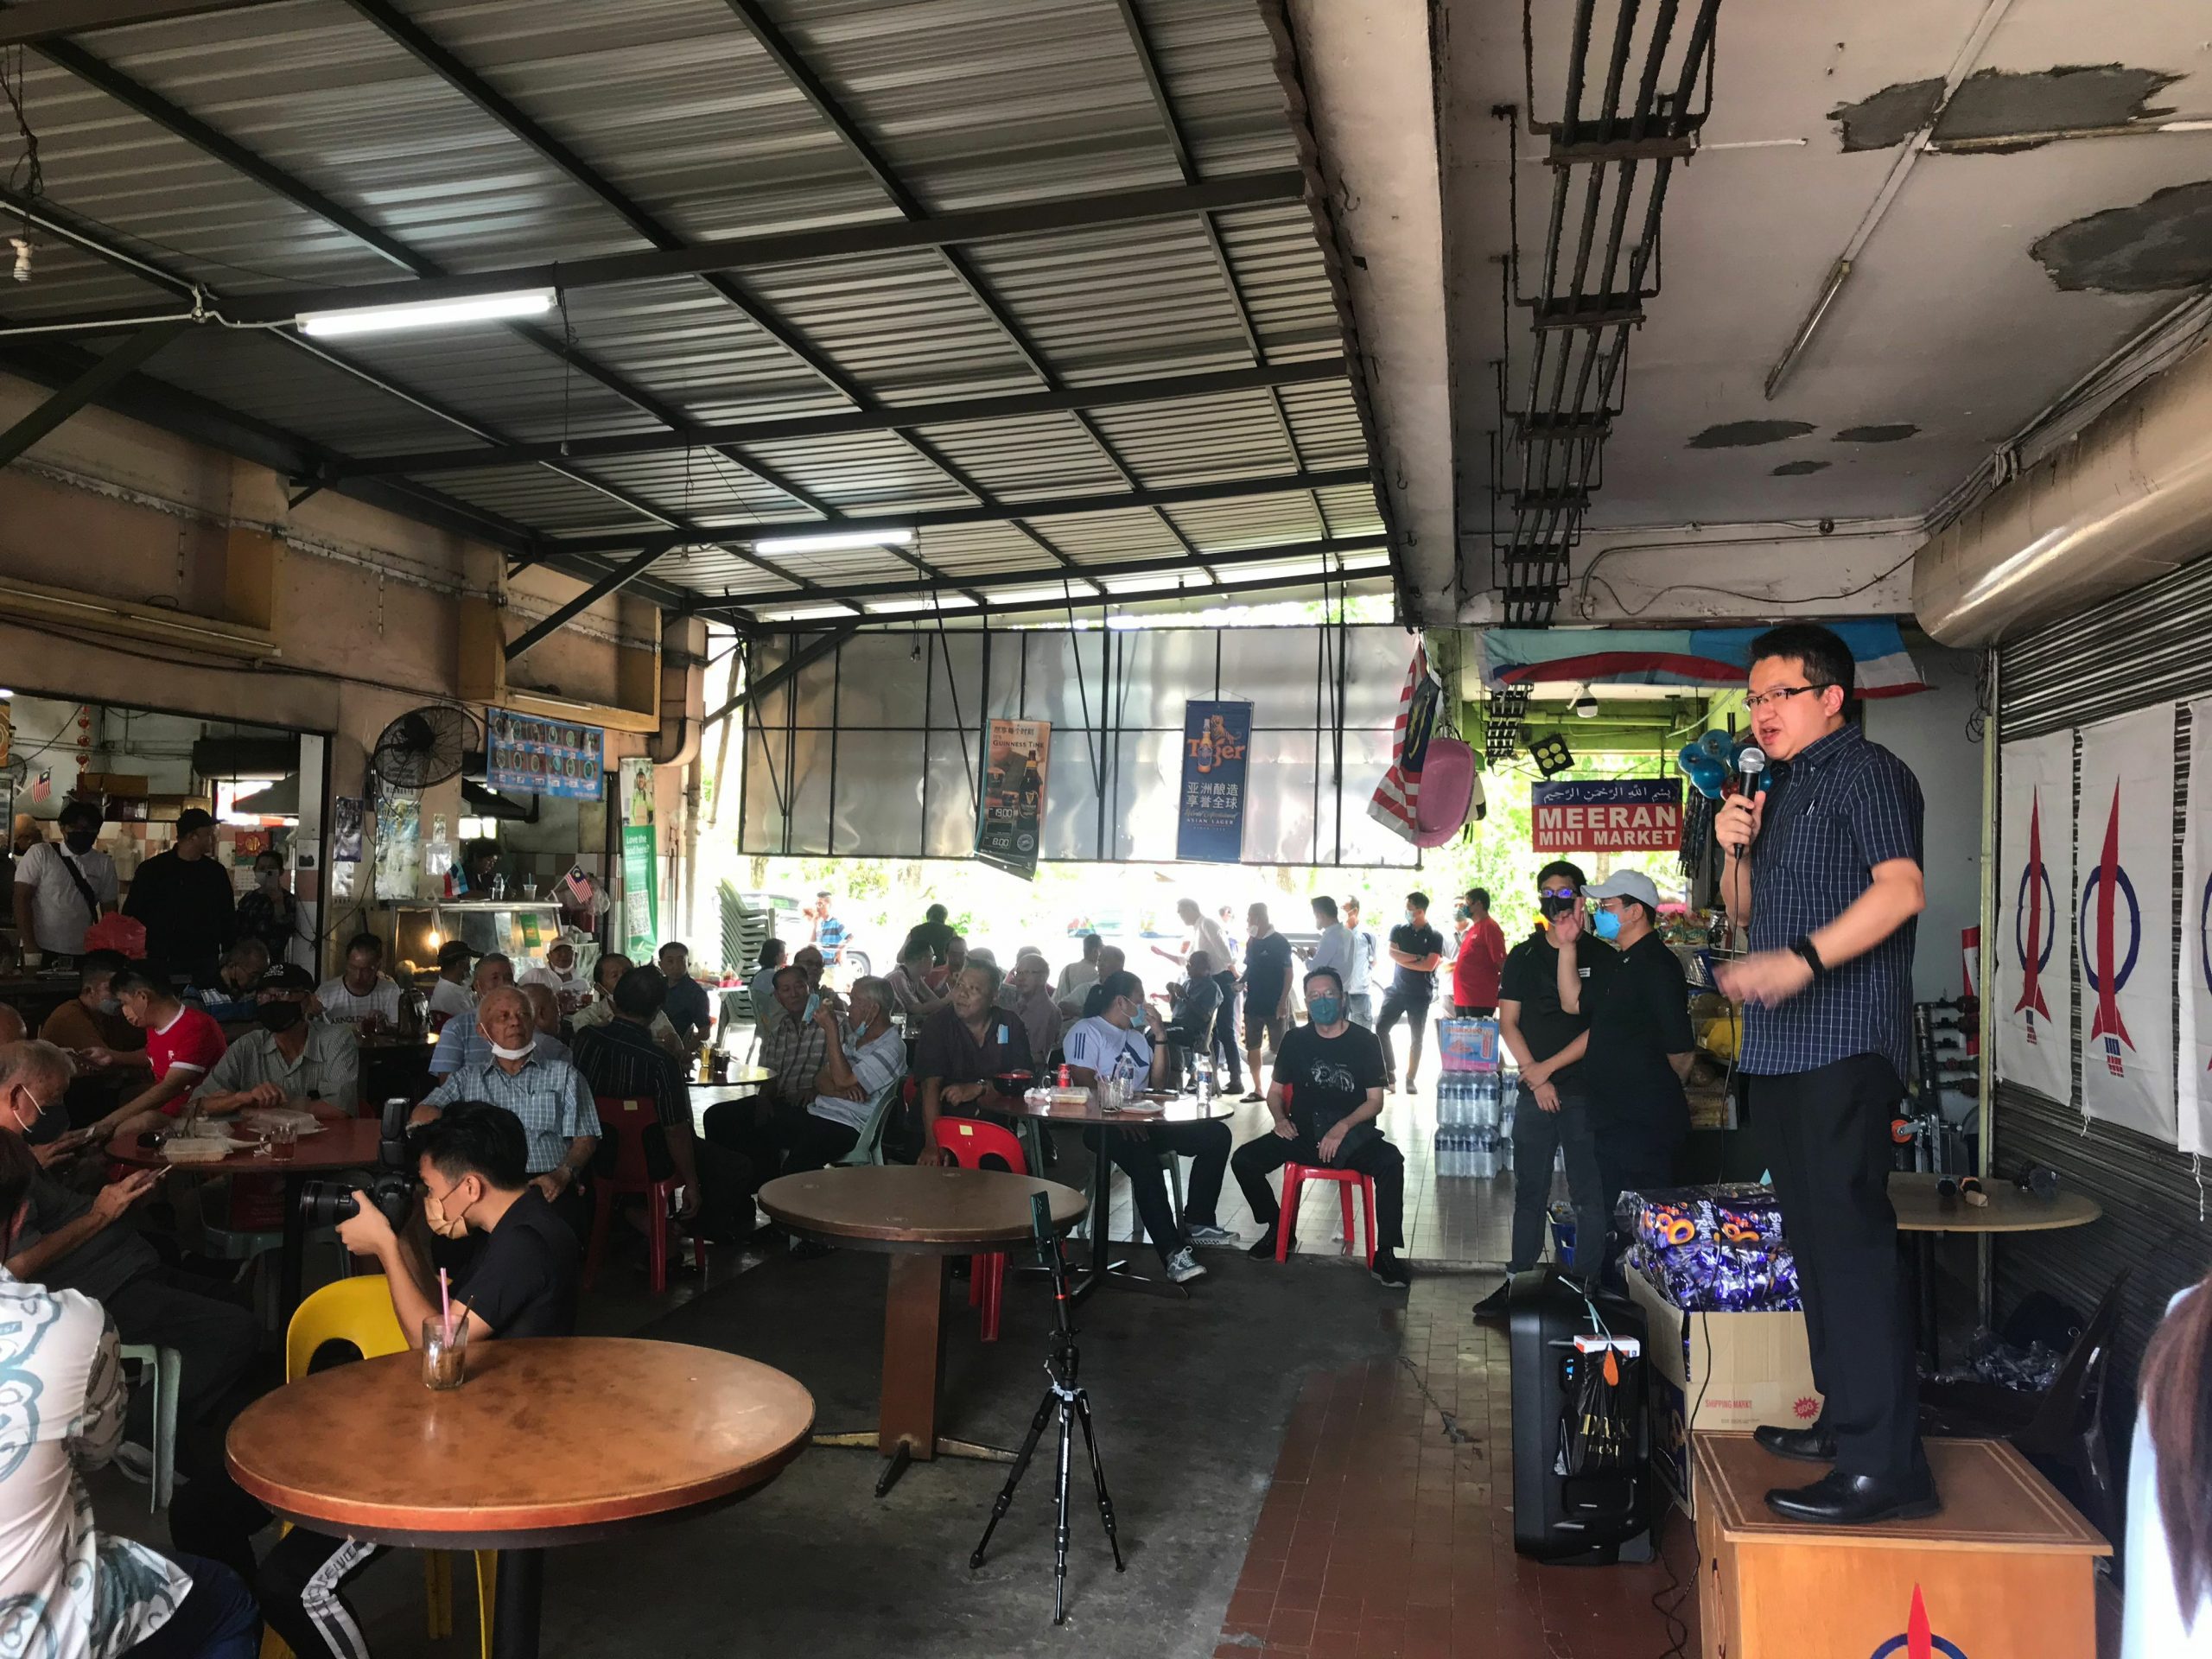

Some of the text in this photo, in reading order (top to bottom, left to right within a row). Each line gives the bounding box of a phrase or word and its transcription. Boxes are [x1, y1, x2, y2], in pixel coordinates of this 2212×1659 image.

[993, 740, 1027, 748] GUINNESS
[1187, 781, 1238, 797] 亚洲酿造
[1186, 794, 1237, 810] 享誉全球
[1538, 806, 1676, 830] MEERAN
[626, 836, 638, 844] Love
[1539, 830, 1676, 846] MINI MARKET
[1705, 1399, 1732, 1409] SHIPPING
